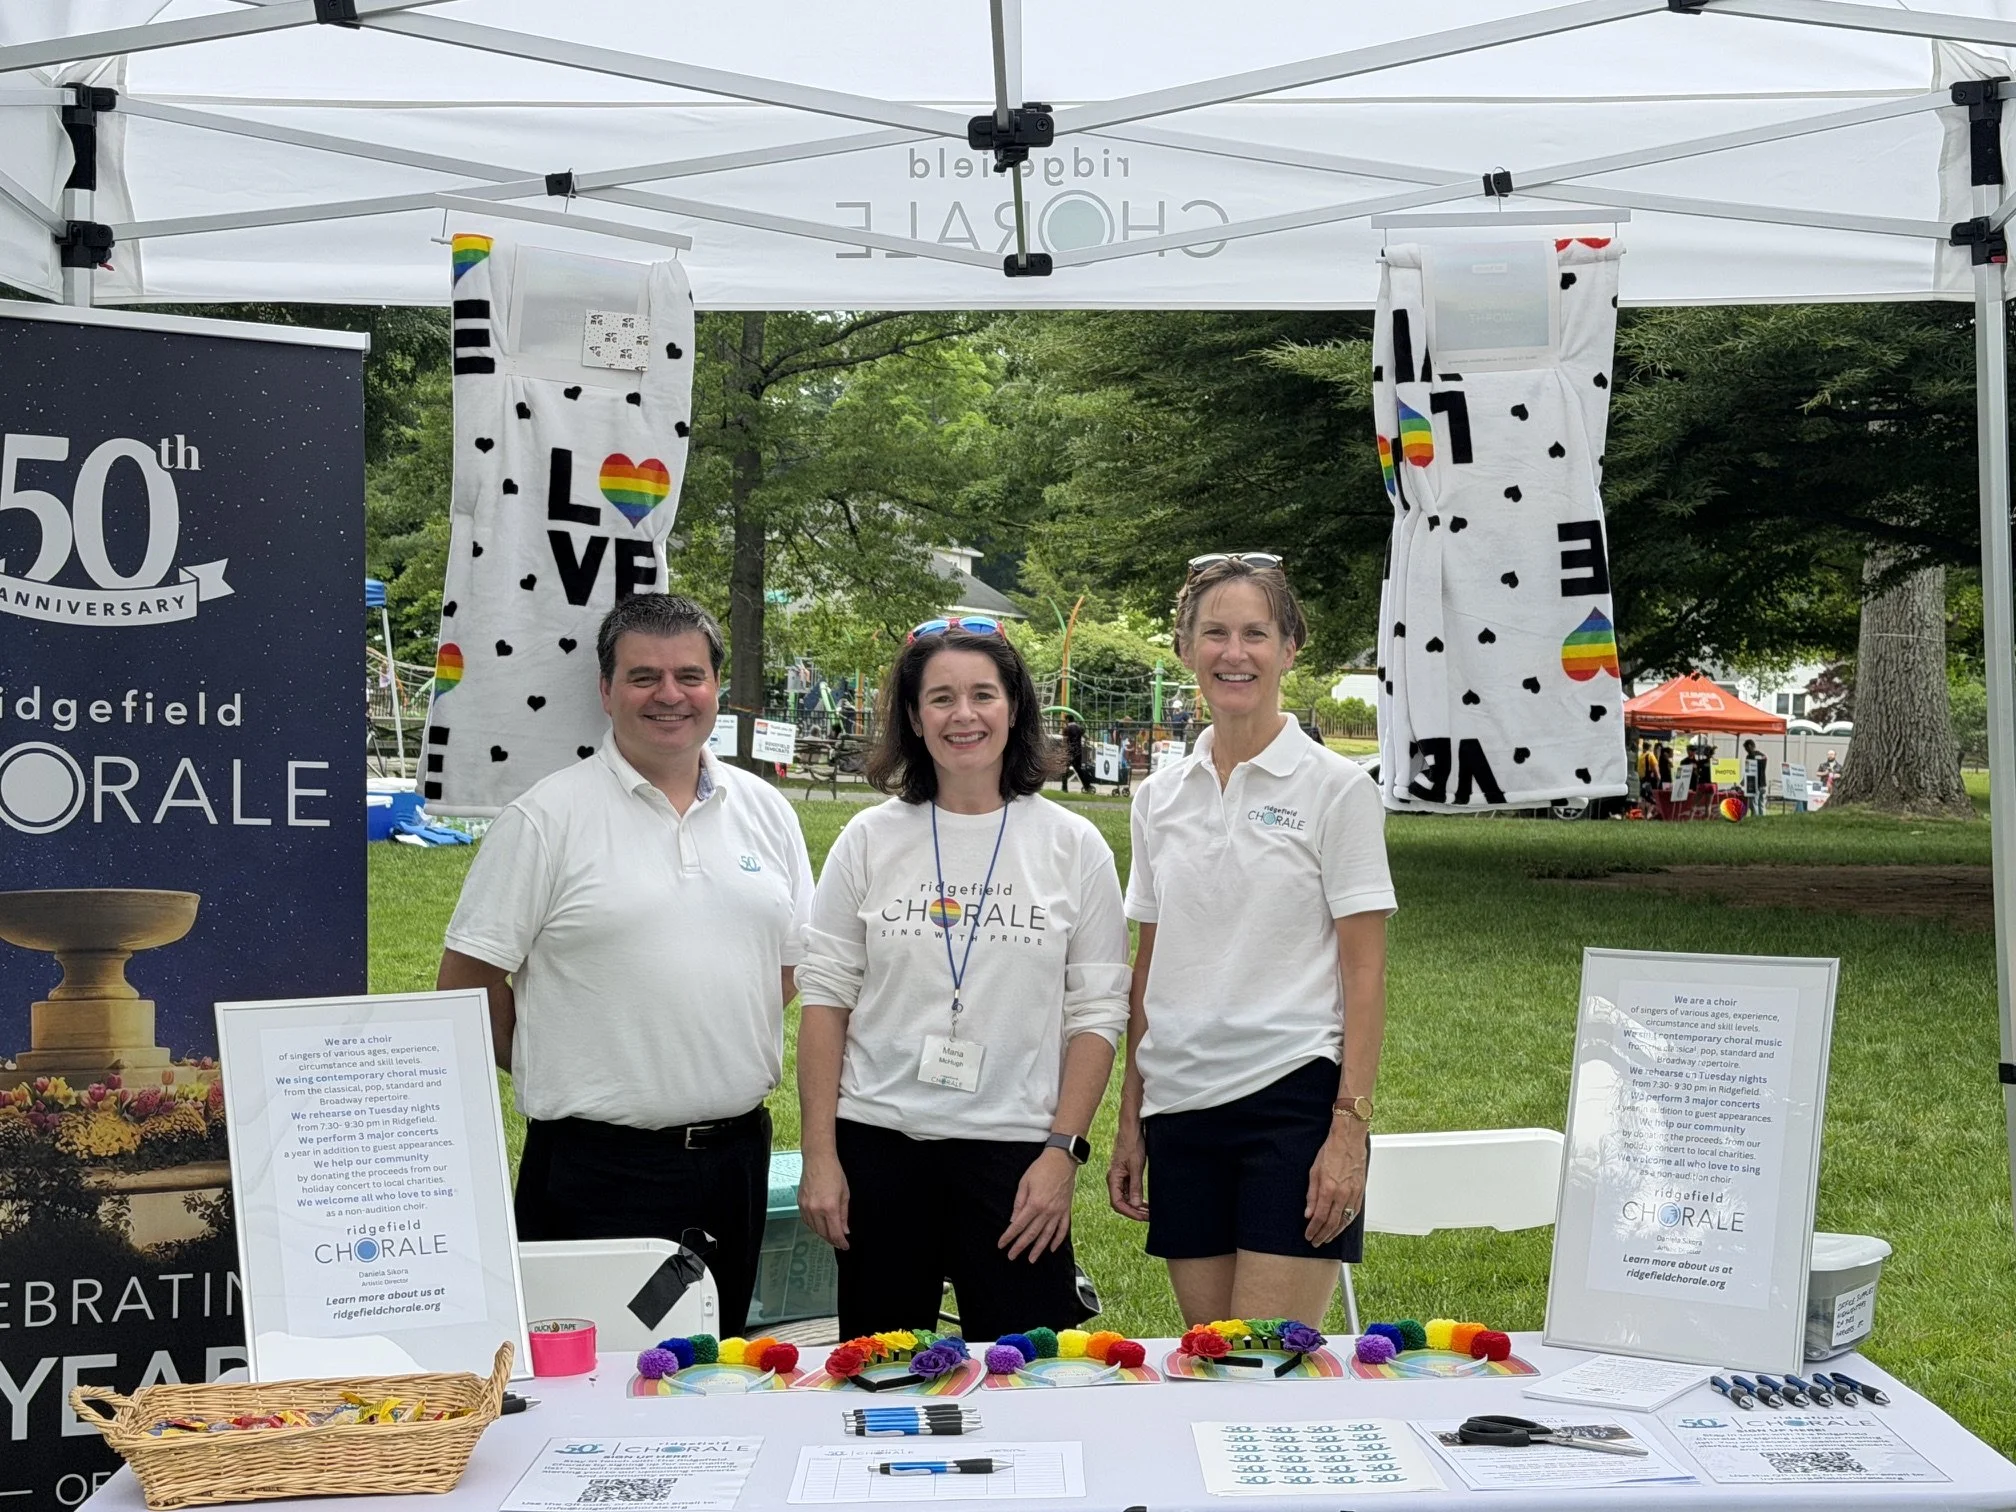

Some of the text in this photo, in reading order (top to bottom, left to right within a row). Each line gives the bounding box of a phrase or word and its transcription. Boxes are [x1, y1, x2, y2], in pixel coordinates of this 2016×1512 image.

[0, 587, 185, 616] ANNIVERSARY
[1264, 805, 1298, 817] ridgefield
[1248, 810, 1306, 830] CHORALE
[920, 881, 1013, 897] ridgefield
[881, 897, 1046, 931] CHORALE
[882, 928, 1043, 945] SING WITH PRIDE
[1674, 995, 1737, 1006] We choir
[1639, 1006, 1668, 1018] singers
[1679, 1007, 1709, 1018] various
[1700, 1020, 1716, 1030] and
[1716, 1021, 1733, 1030] skill
[324, 1037, 340, 1046] We
[367, 1034, 392, 1044] choir
[1723, 1034, 1782, 1046] choral music
[289, 1052, 321, 1063] singers
[332, 1047, 365, 1058] various
[1719, 1046, 1757, 1057] standard
[1758, 1048, 1774, 1058] and
[298, 1058, 358, 1071] circumstance
[358, 1058, 375, 1067] and
[376, 1057, 394, 1067] skill
[275, 1066, 447, 1085] We sing contemporary choral music
[1697, 1070, 1767, 1085] Tuesday nights
[283, 1086, 305, 1096] from
[306, 1085, 322, 1095] the
[385, 1080, 424, 1091] standard
[425, 1079, 442, 1087] and
[319, 1094, 364, 1108] Broadway
[1691, 1096, 1718, 1108] major
[1719, 1099, 1760, 1108] concerts
[290, 1103, 440, 1120] We rehearse Tuesday nights
[297, 1122, 318, 1131] from
[365, 1120, 381, 1130] pm
[1693, 1120, 1746, 1135] community
[297, 1127, 439, 1145] We perform 3 major concerts
[1684, 1134, 1724, 1147] proceeds
[290, 1150, 312, 1159] year
[322, 1144, 360, 1156] addition
[372, 1141, 397, 1155] guest
[1697, 1146, 1717, 1156] local
[313, 1159, 329, 1168] We
[331, 1156, 353, 1169] help
[374, 1152, 429, 1167] community
[1707, 1160, 1760, 1175] love sing
[309, 1169, 350, 1184] donating
[350, 1168, 366, 1178] the
[367, 1166, 409, 1180] proceeds
[409, 1164, 431, 1175] from
[301, 1182, 336, 1196] holiday
[335, 1180, 371, 1191] concert
[382, 1177, 405, 1188] local
[296, 1187, 452, 1206] We welcome all who love sing
[1654, 1188, 1724, 1203] ridgefield
[344, 1203, 401, 1216] non-audition
[1622, 1201, 1745, 1232] CHORALE
[347, 1220, 421, 1237] ridgefield
[314, 1234, 448, 1264] CHORALE
[1622, 1254, 1707, 1270] Learn more about
[1626, 1268, 1726, 1290] ridgefieldchorale.org
[326, 1296, 356, 1305] Learn
[358, 1294, 385, 1302] more
[387, 1289, 418, 1300] about
[433, 1287, 445, 1295] at
[333, 1302, 441, 1320] ridgefieldchorale.org
[534, 1324, 551, 1332] DUCK
[1747, 1419, 1876, 1427] CHORALE
[624, 1445, 750, 1453] CHORALE
